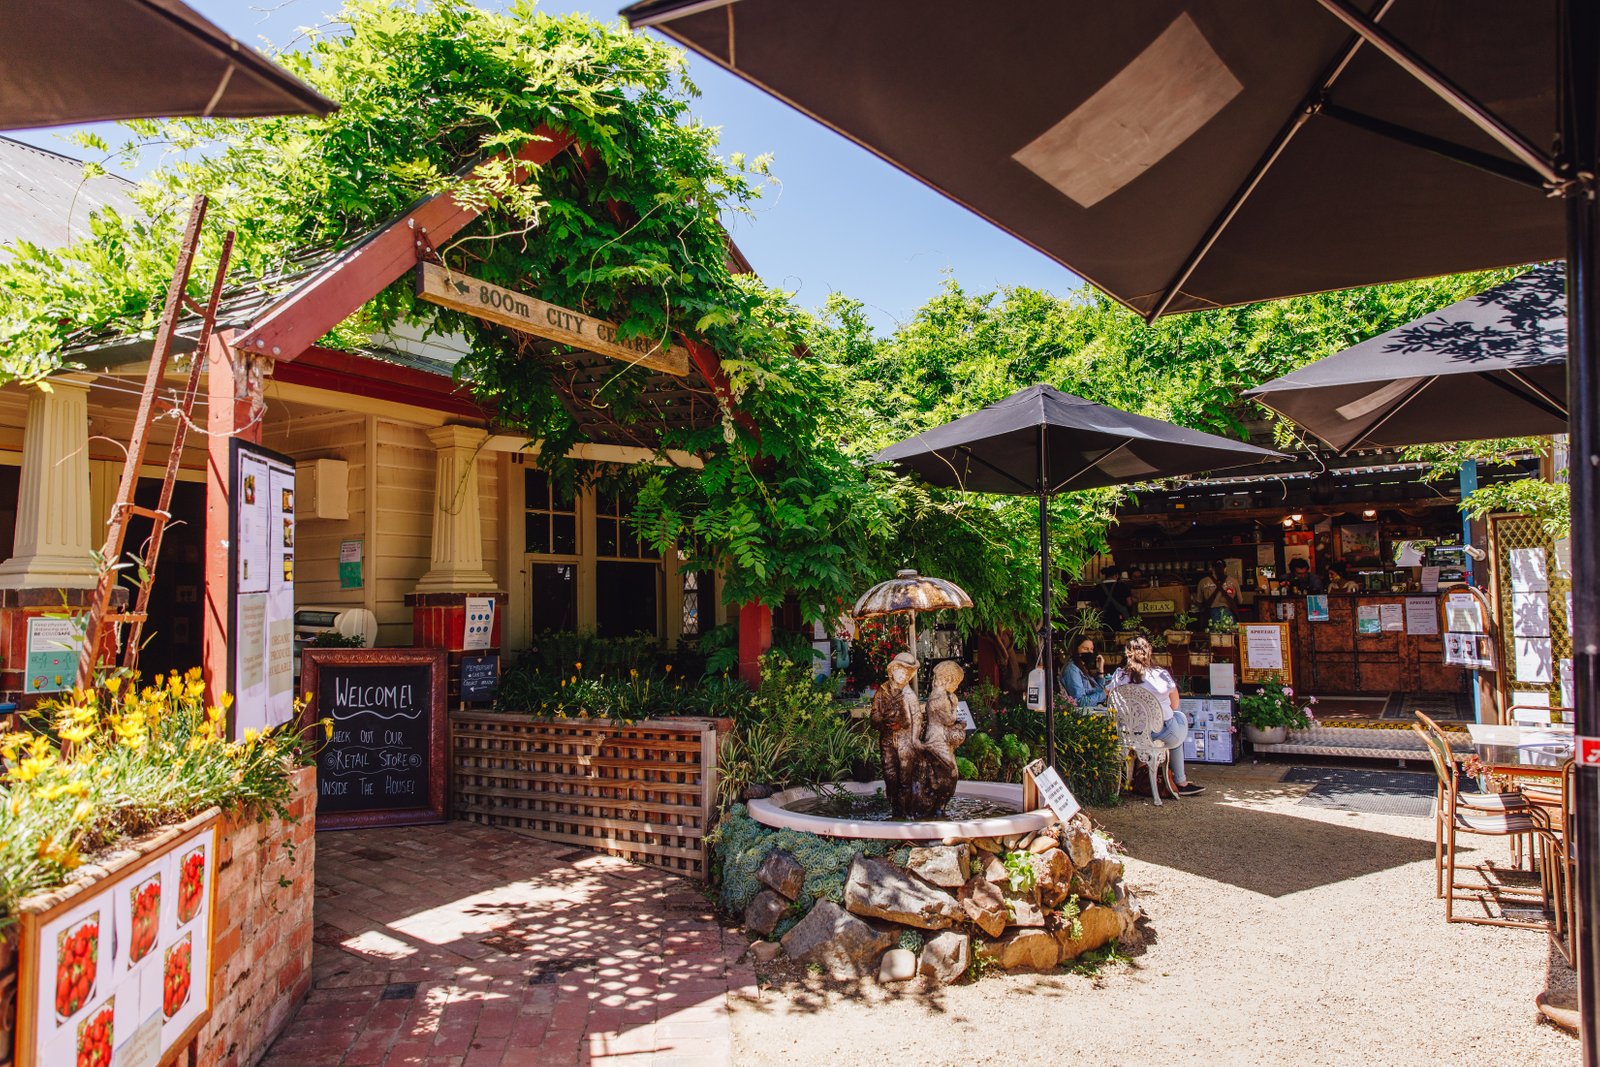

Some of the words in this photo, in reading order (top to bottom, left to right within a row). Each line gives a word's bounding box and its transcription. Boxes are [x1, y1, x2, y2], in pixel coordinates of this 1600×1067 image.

[480, 286, 530, 318] 800m
[547, 308, 585, 335] CITY
[597, 324, 656, 355] CETRE
[336, 677, 414, 711] WELCOME!
[327, 730, 351, 743] HECK
[360, 730, 374, 744] OUT
[384, 730, 404, 745] OUR
[336, 751, 370, 770] RETAIL
[379, 750, 409, 767] STORE
[321, 778, 348, 796] INSIDE
[358, 777, 374, 795] THE
[385, 775, 415, 795] HOUSE!
